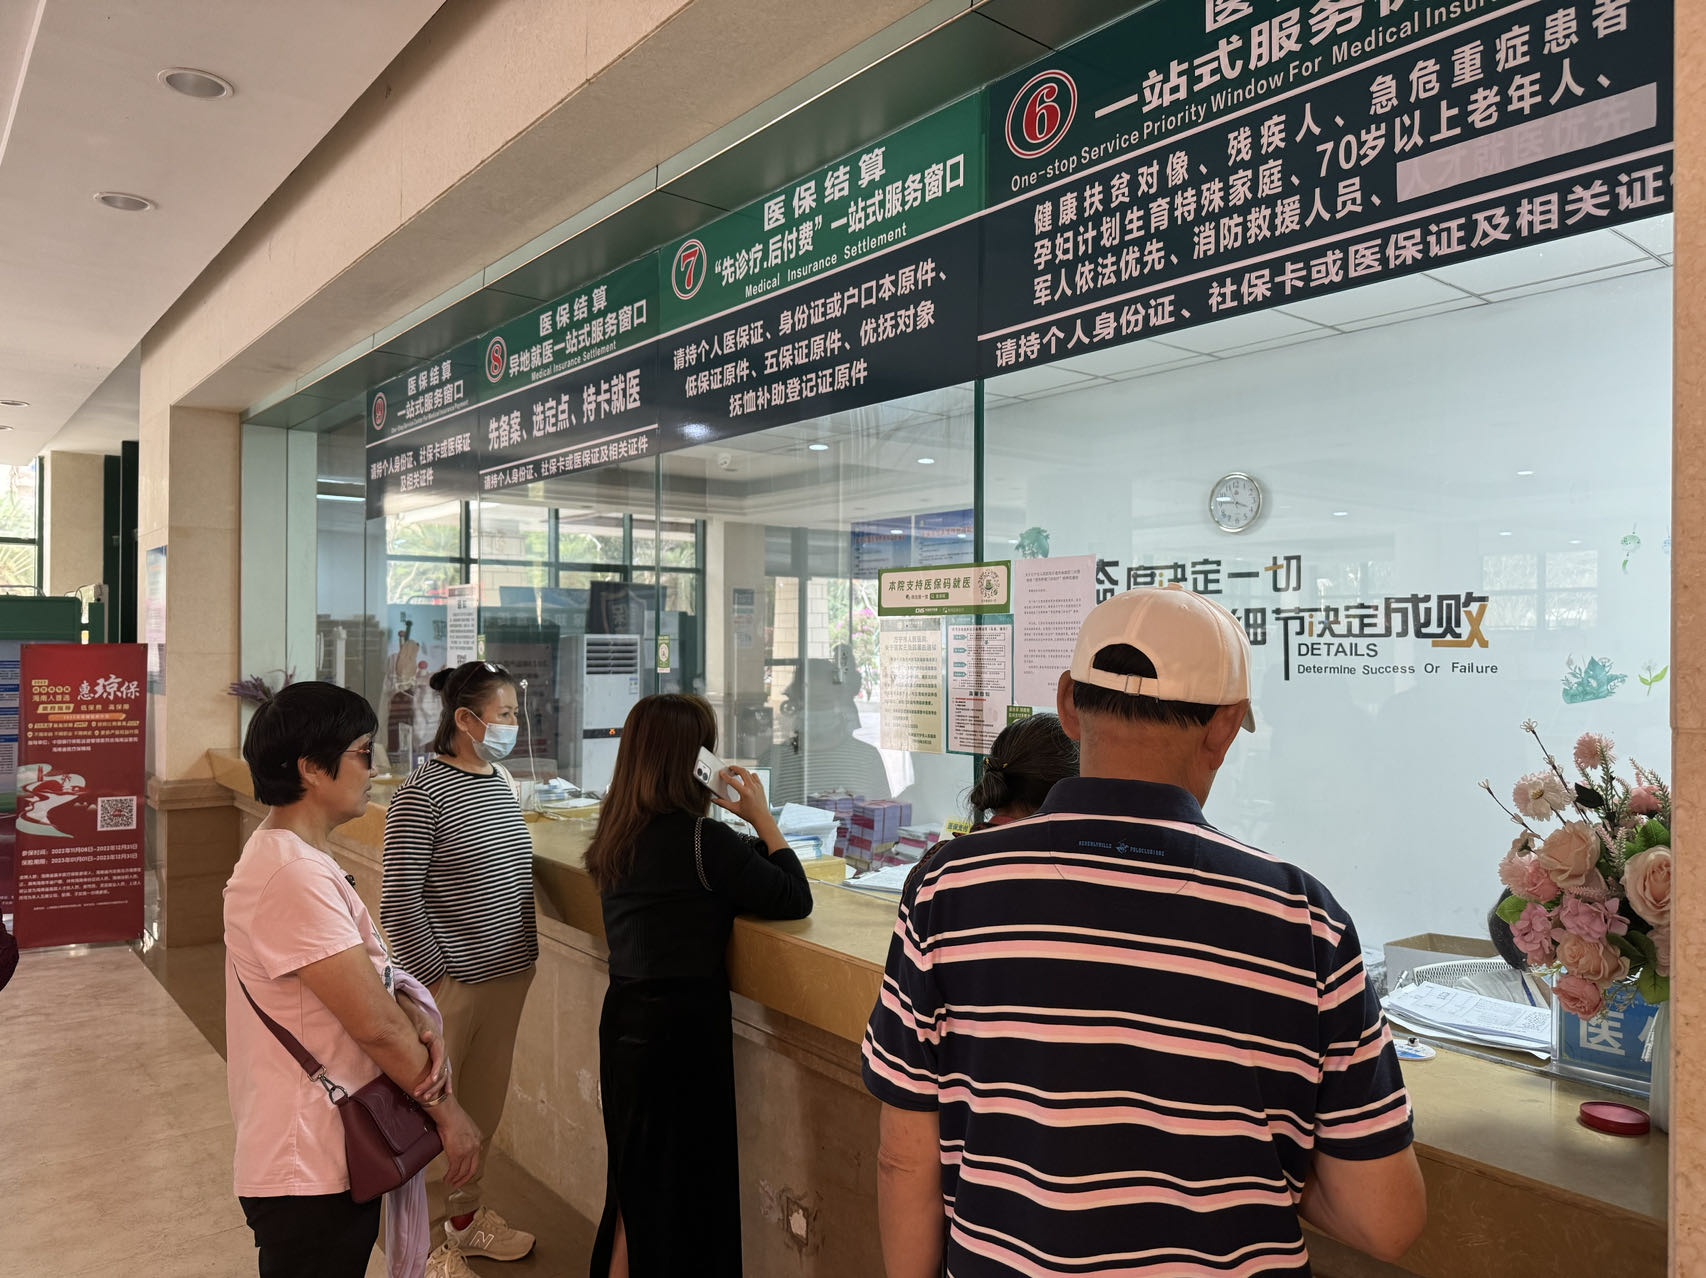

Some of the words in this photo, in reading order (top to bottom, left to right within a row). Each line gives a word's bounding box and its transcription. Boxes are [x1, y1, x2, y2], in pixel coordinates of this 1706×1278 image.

[1094, 0, 1402, 119] 一站式服务
[1011, 155, 1077, 192] One-stop
[1080, 130, 1139, 164] Service
[1143, 102, 1207, 140] Priority
[1210, 70, 1284, 112] Window
[1289, 54, 1322, 82] For
[1332, 12, 1418, 65] Medical
[763, 146, 886, 232] 医保结算
[745, 273, 780, 298] Medical
[787, 253, 837, 280] Insurance
[843, 223, 907, 260] Settlement
[995, 165, 1674, 367] 请持个人身份证、社保卡或医保证及相关证
[539, 285, 608, 337] 医保结算
[509, 299, 647, 378] 异地就医一站式服务窗口
[531, 367, 552, 382] Medical
[553, 354, 581, 373] Insurance
[582, 340, 617, 362] Settlement
[397, 379, 464, 419] 一站式服务窗口
[407, 360, 452, 396] 医保结算
[729, 358, 868, 417] 抚恤补助登记证原件
[488, 368, 641, 451] 先备案、选定点、持卡就医
[400, 467, 434, 492] 及相关证件
[888, 577, 971, 592] 本院支持医保码就医
[1297, 642, 1379, 658] DETAILS
[1361, 664, 1416, 675] Success
[1424, 663, 1440, 674] Or
[1450, 662, 1498, 674] Failure
[77, 674, 140, 701] 惠琼保
